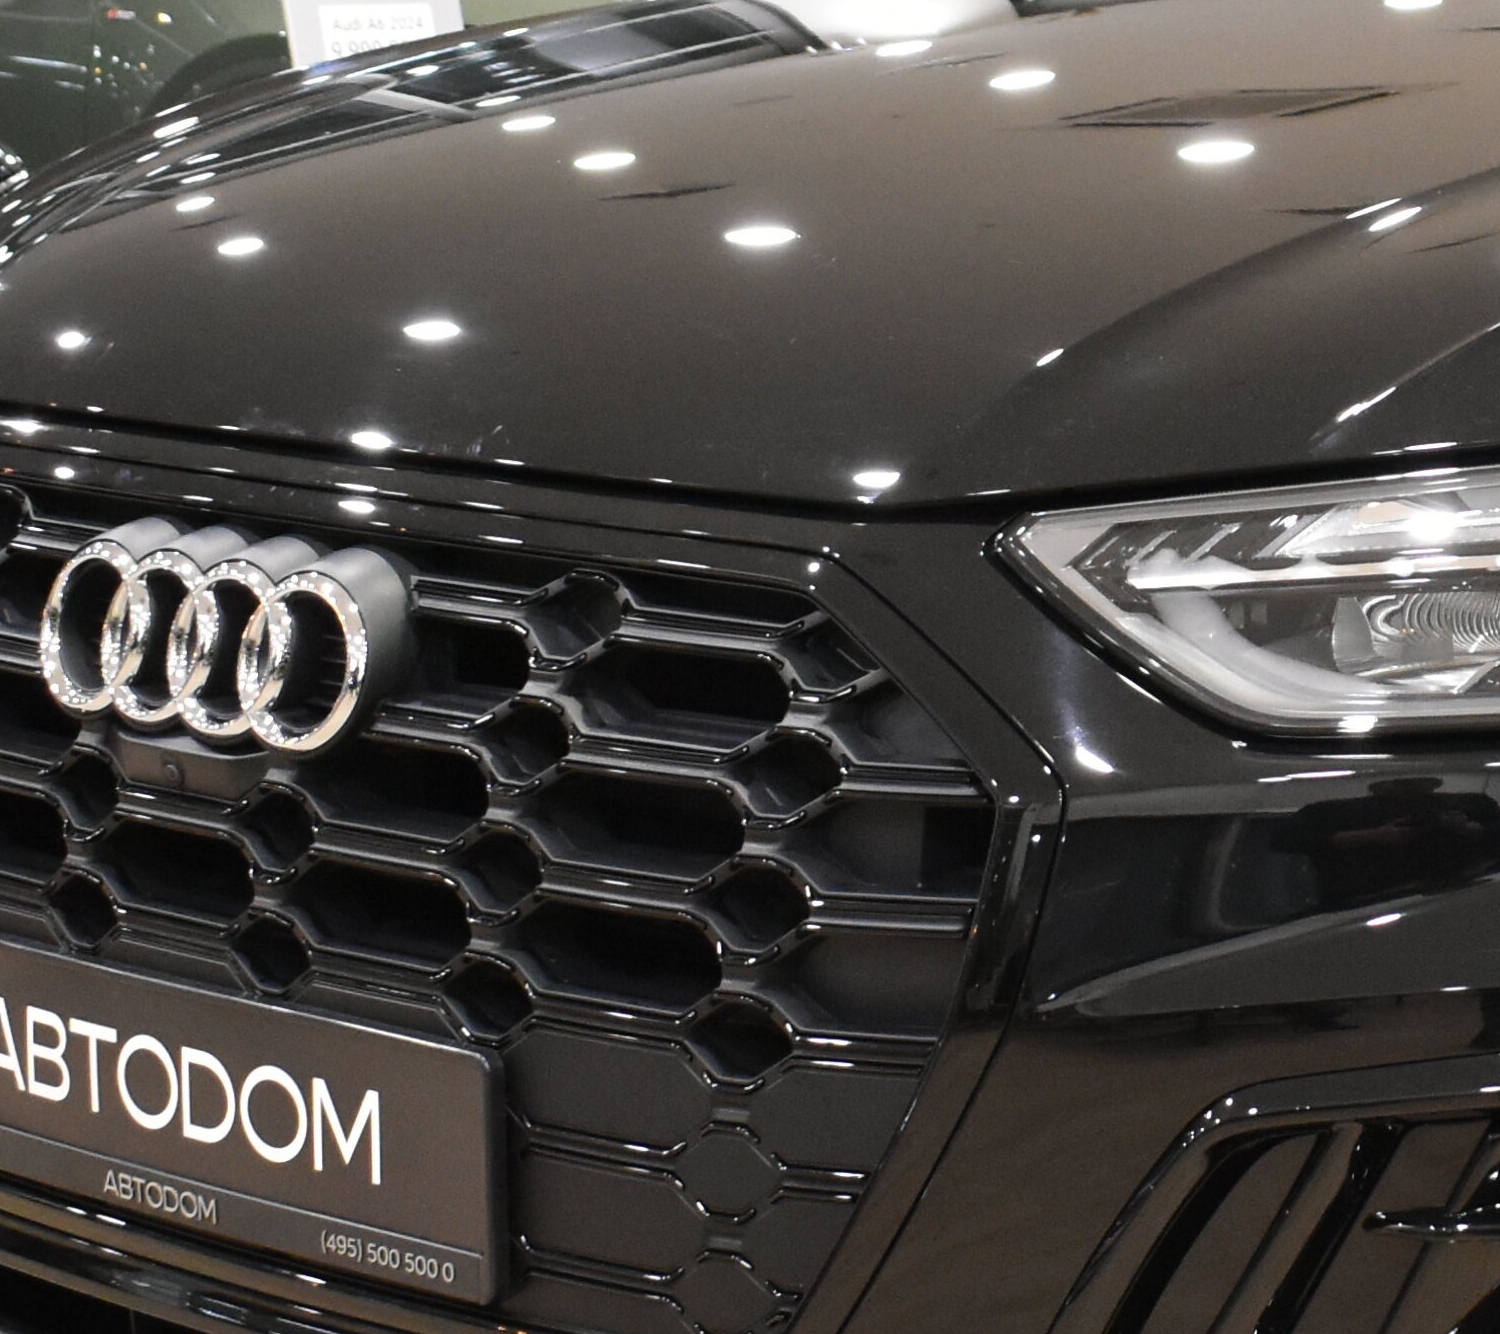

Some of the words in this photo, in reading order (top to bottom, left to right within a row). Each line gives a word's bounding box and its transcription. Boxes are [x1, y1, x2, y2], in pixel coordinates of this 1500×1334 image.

[321, 1229, 363, 1263] (495)
[367, 1242, 400, 1269] 500
[405, 1252, 439, 1279] 500
[442, 1262, 455, 1283] 0
